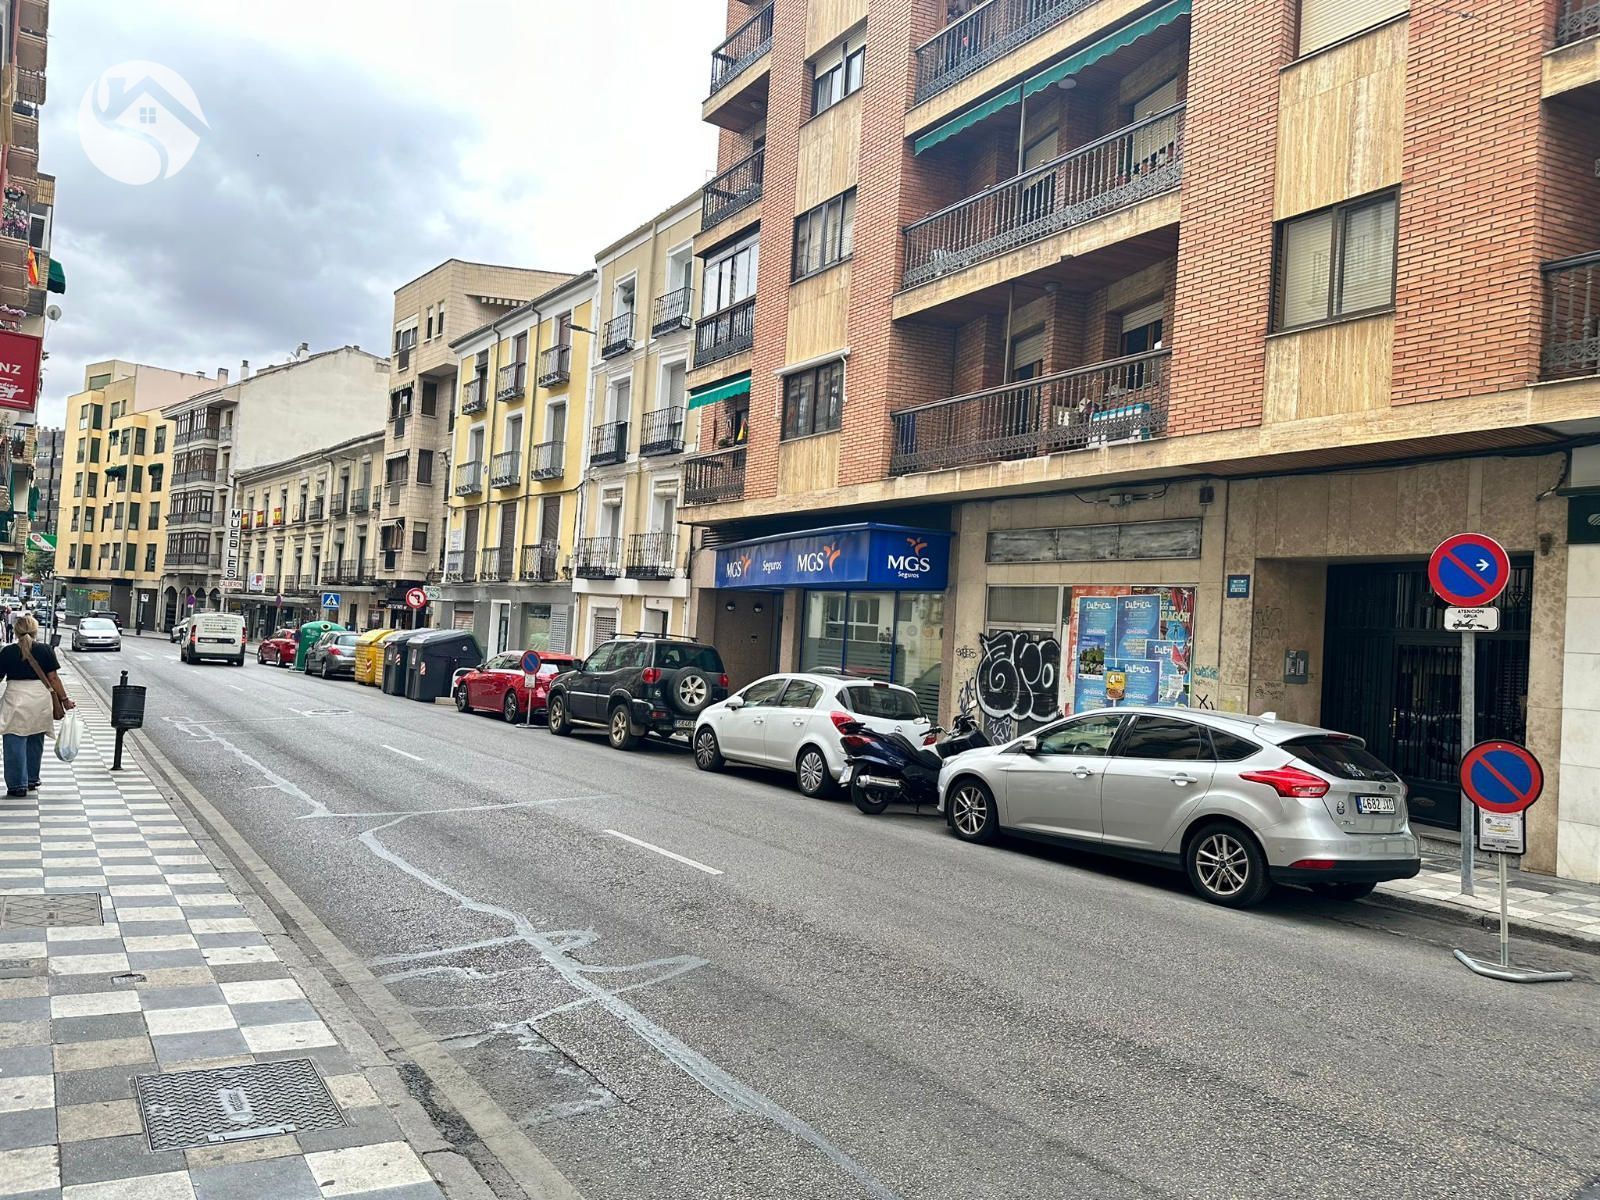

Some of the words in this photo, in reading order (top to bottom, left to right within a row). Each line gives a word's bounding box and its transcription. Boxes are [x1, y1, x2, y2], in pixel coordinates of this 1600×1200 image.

[227, 510, 240, 577] MUEBLES
[726, 561, 742, 578] MGS
[762, 559, 782, 574] Seguros
[797, 552, 824, 573] MGS
[887, 555, 931, 572] MGS
[898, 570, 920, 579] Seguros
[1362, 798, 1381, 810] 4682
